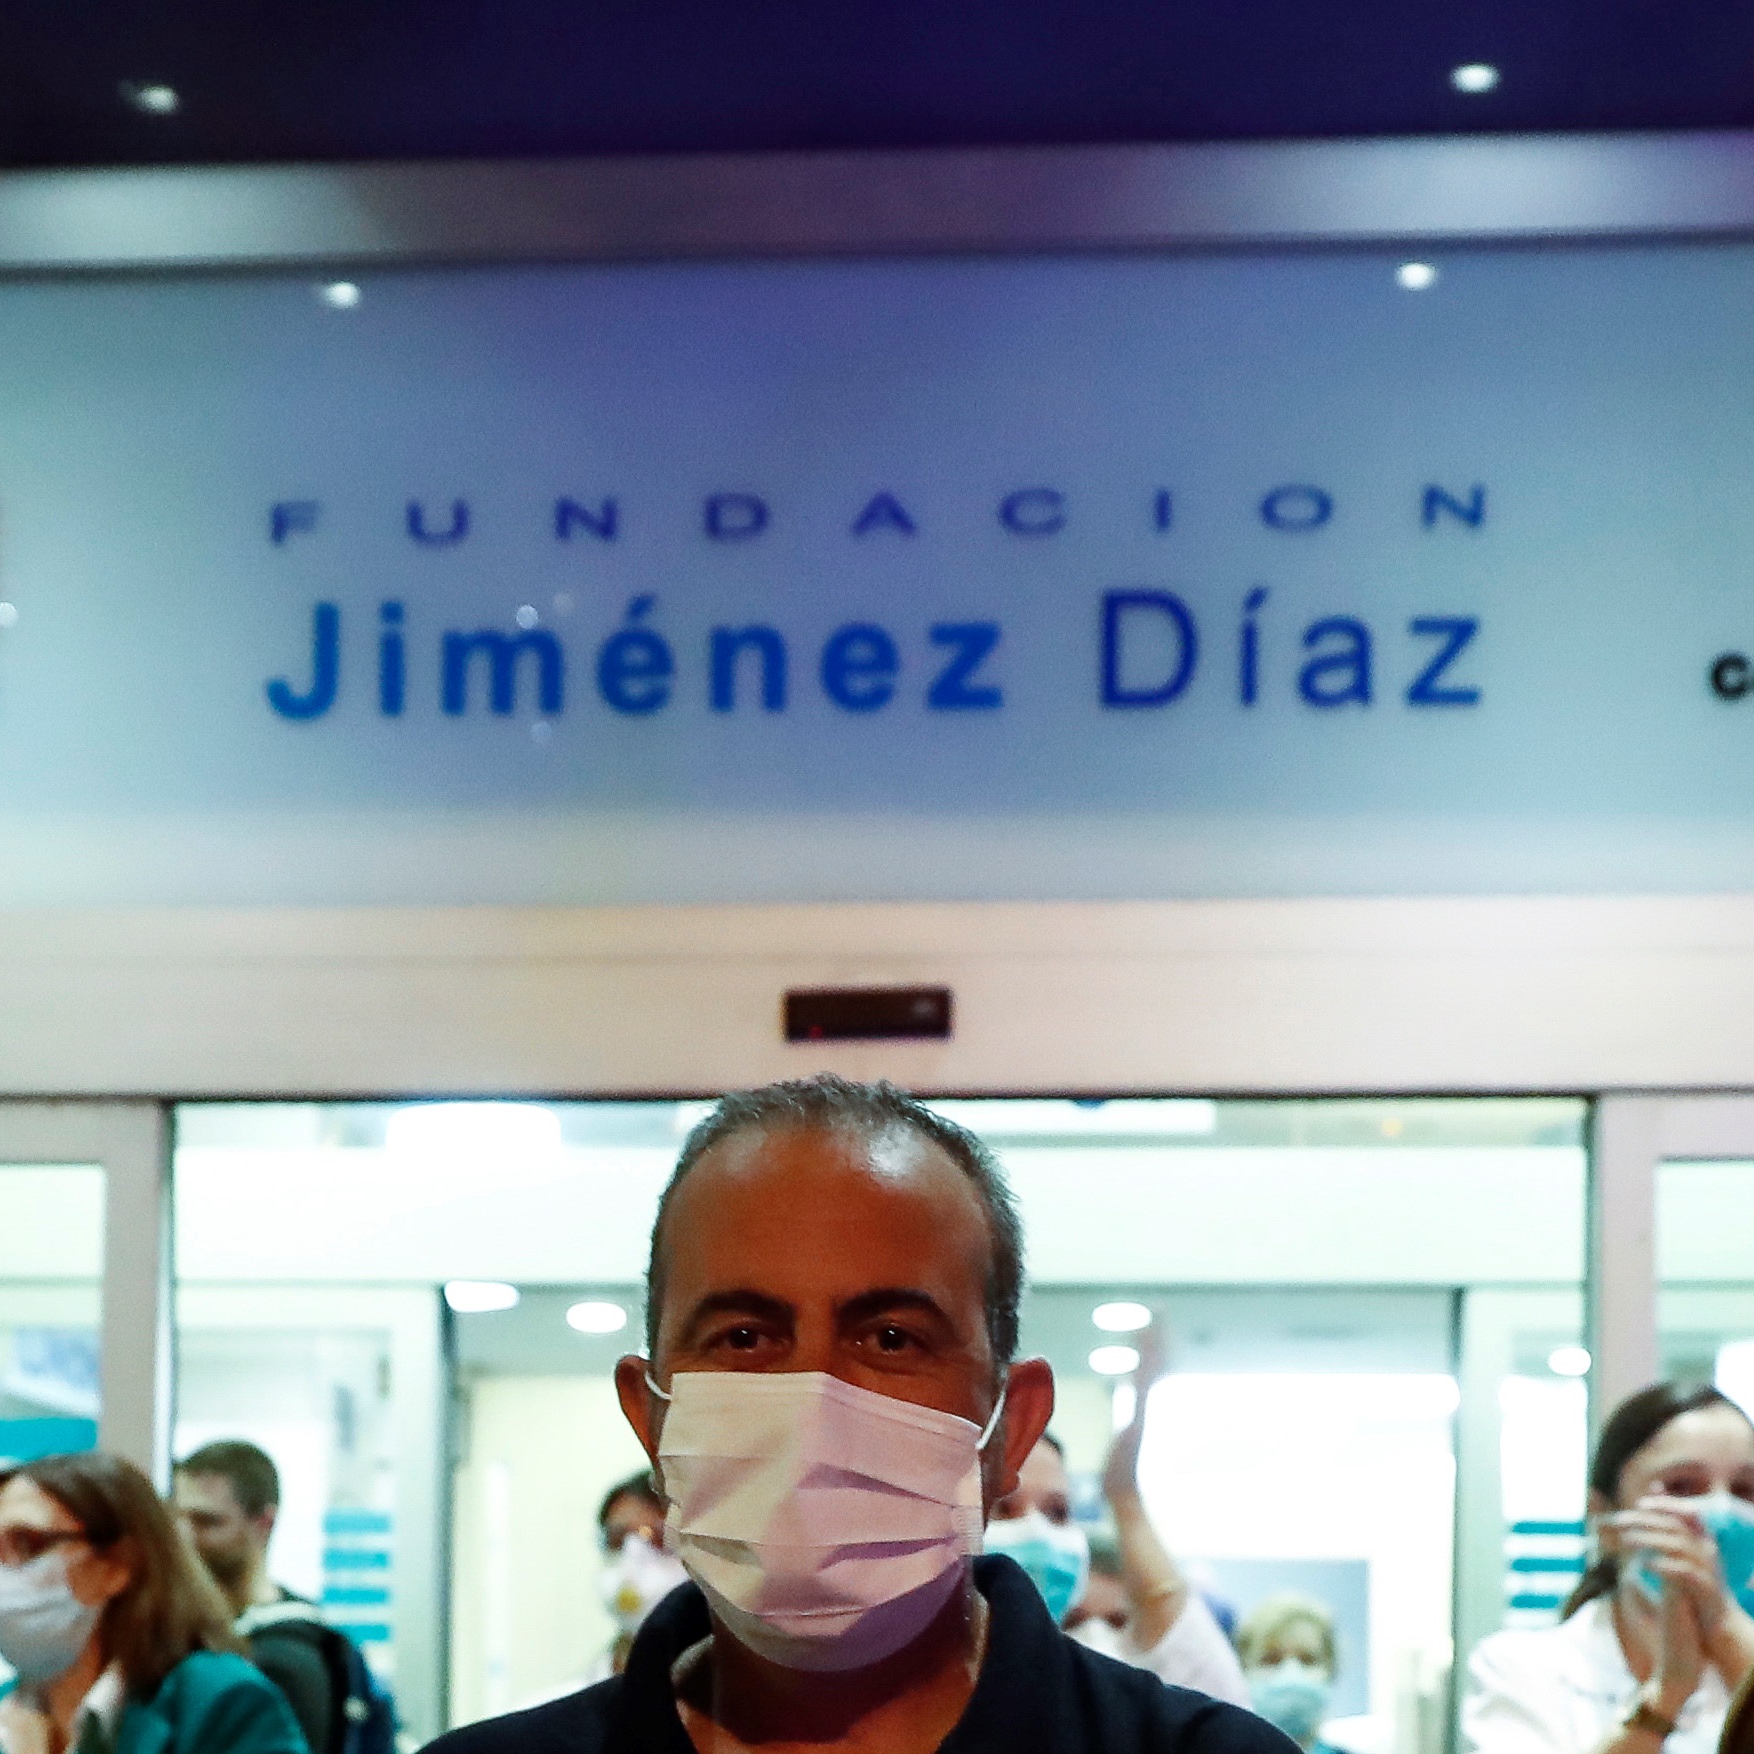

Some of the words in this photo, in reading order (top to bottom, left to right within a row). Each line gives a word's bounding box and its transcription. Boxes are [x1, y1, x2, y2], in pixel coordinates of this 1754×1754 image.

[267, 484, 1489, 548] FUNDACION
[265, 593, 1005, 721] Jiménez
[1096, 587, 1483, 712] Díaz
